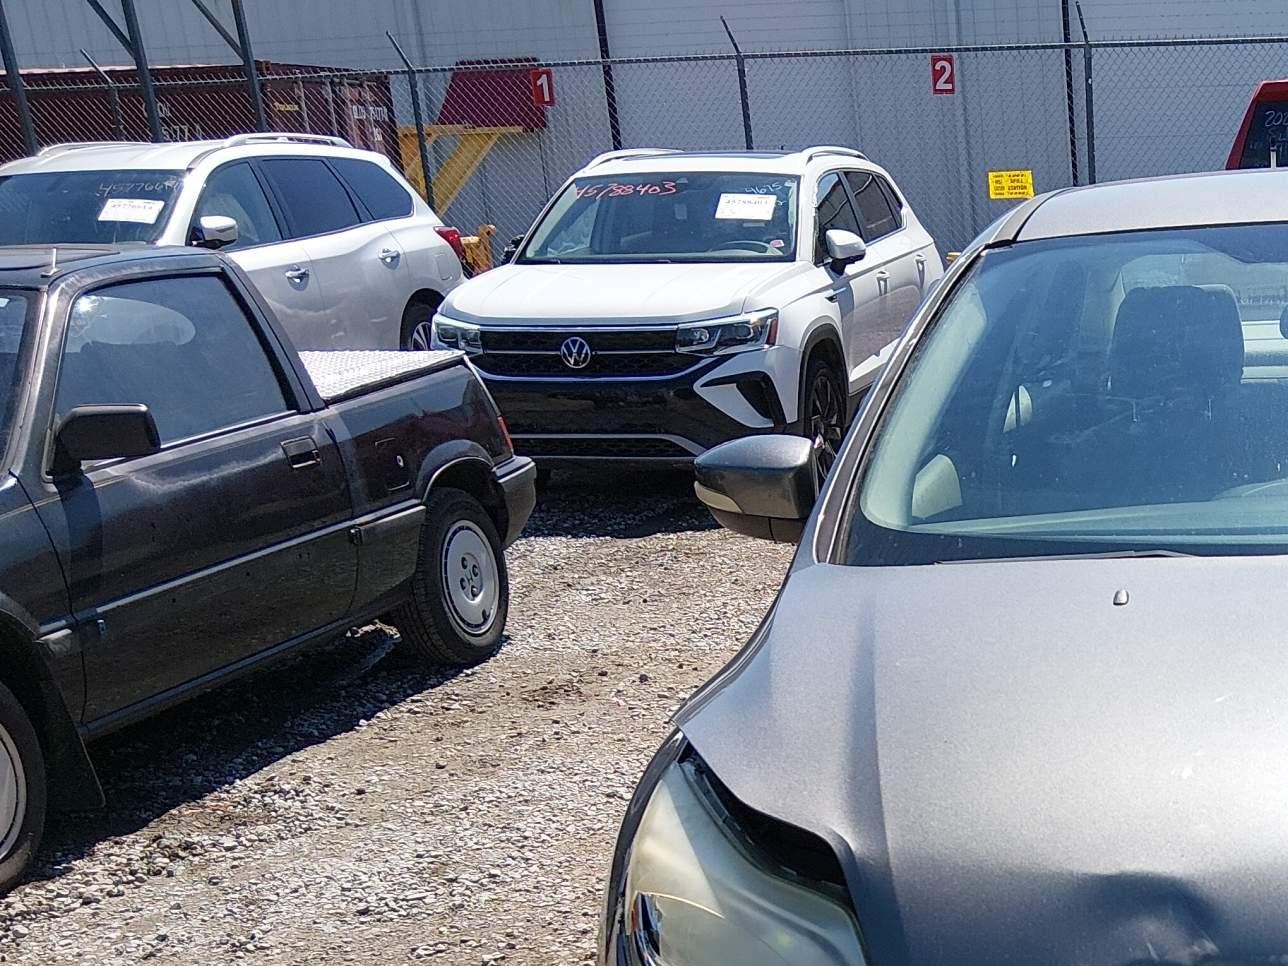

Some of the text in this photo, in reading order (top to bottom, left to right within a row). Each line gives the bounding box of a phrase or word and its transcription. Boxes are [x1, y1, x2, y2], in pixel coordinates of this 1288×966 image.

[537, 74, 549, 101] 1
[935, 60, 952, 89] 2
[575, 182, 677, 200] 45788403
